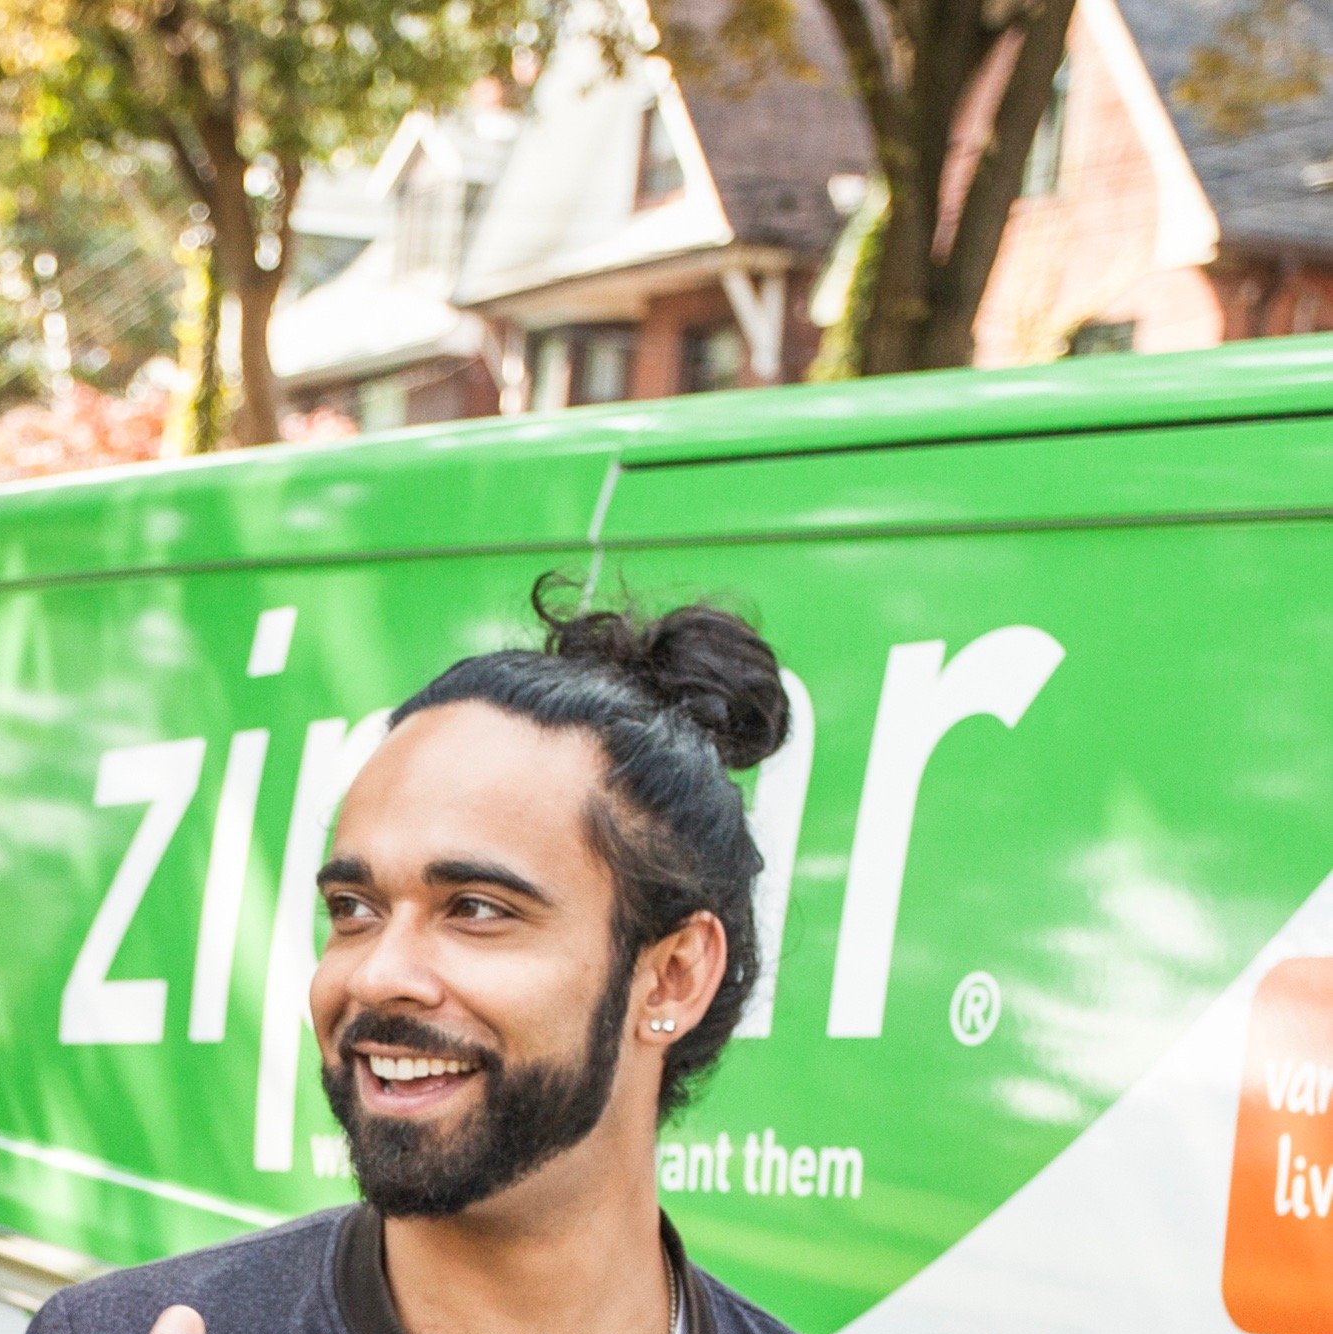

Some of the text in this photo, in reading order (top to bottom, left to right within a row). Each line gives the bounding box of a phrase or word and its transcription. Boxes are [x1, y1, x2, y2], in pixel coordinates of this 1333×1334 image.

[58, 605, 1067, 1173] zipr
[656, 1127, 864, 1199] ant them
